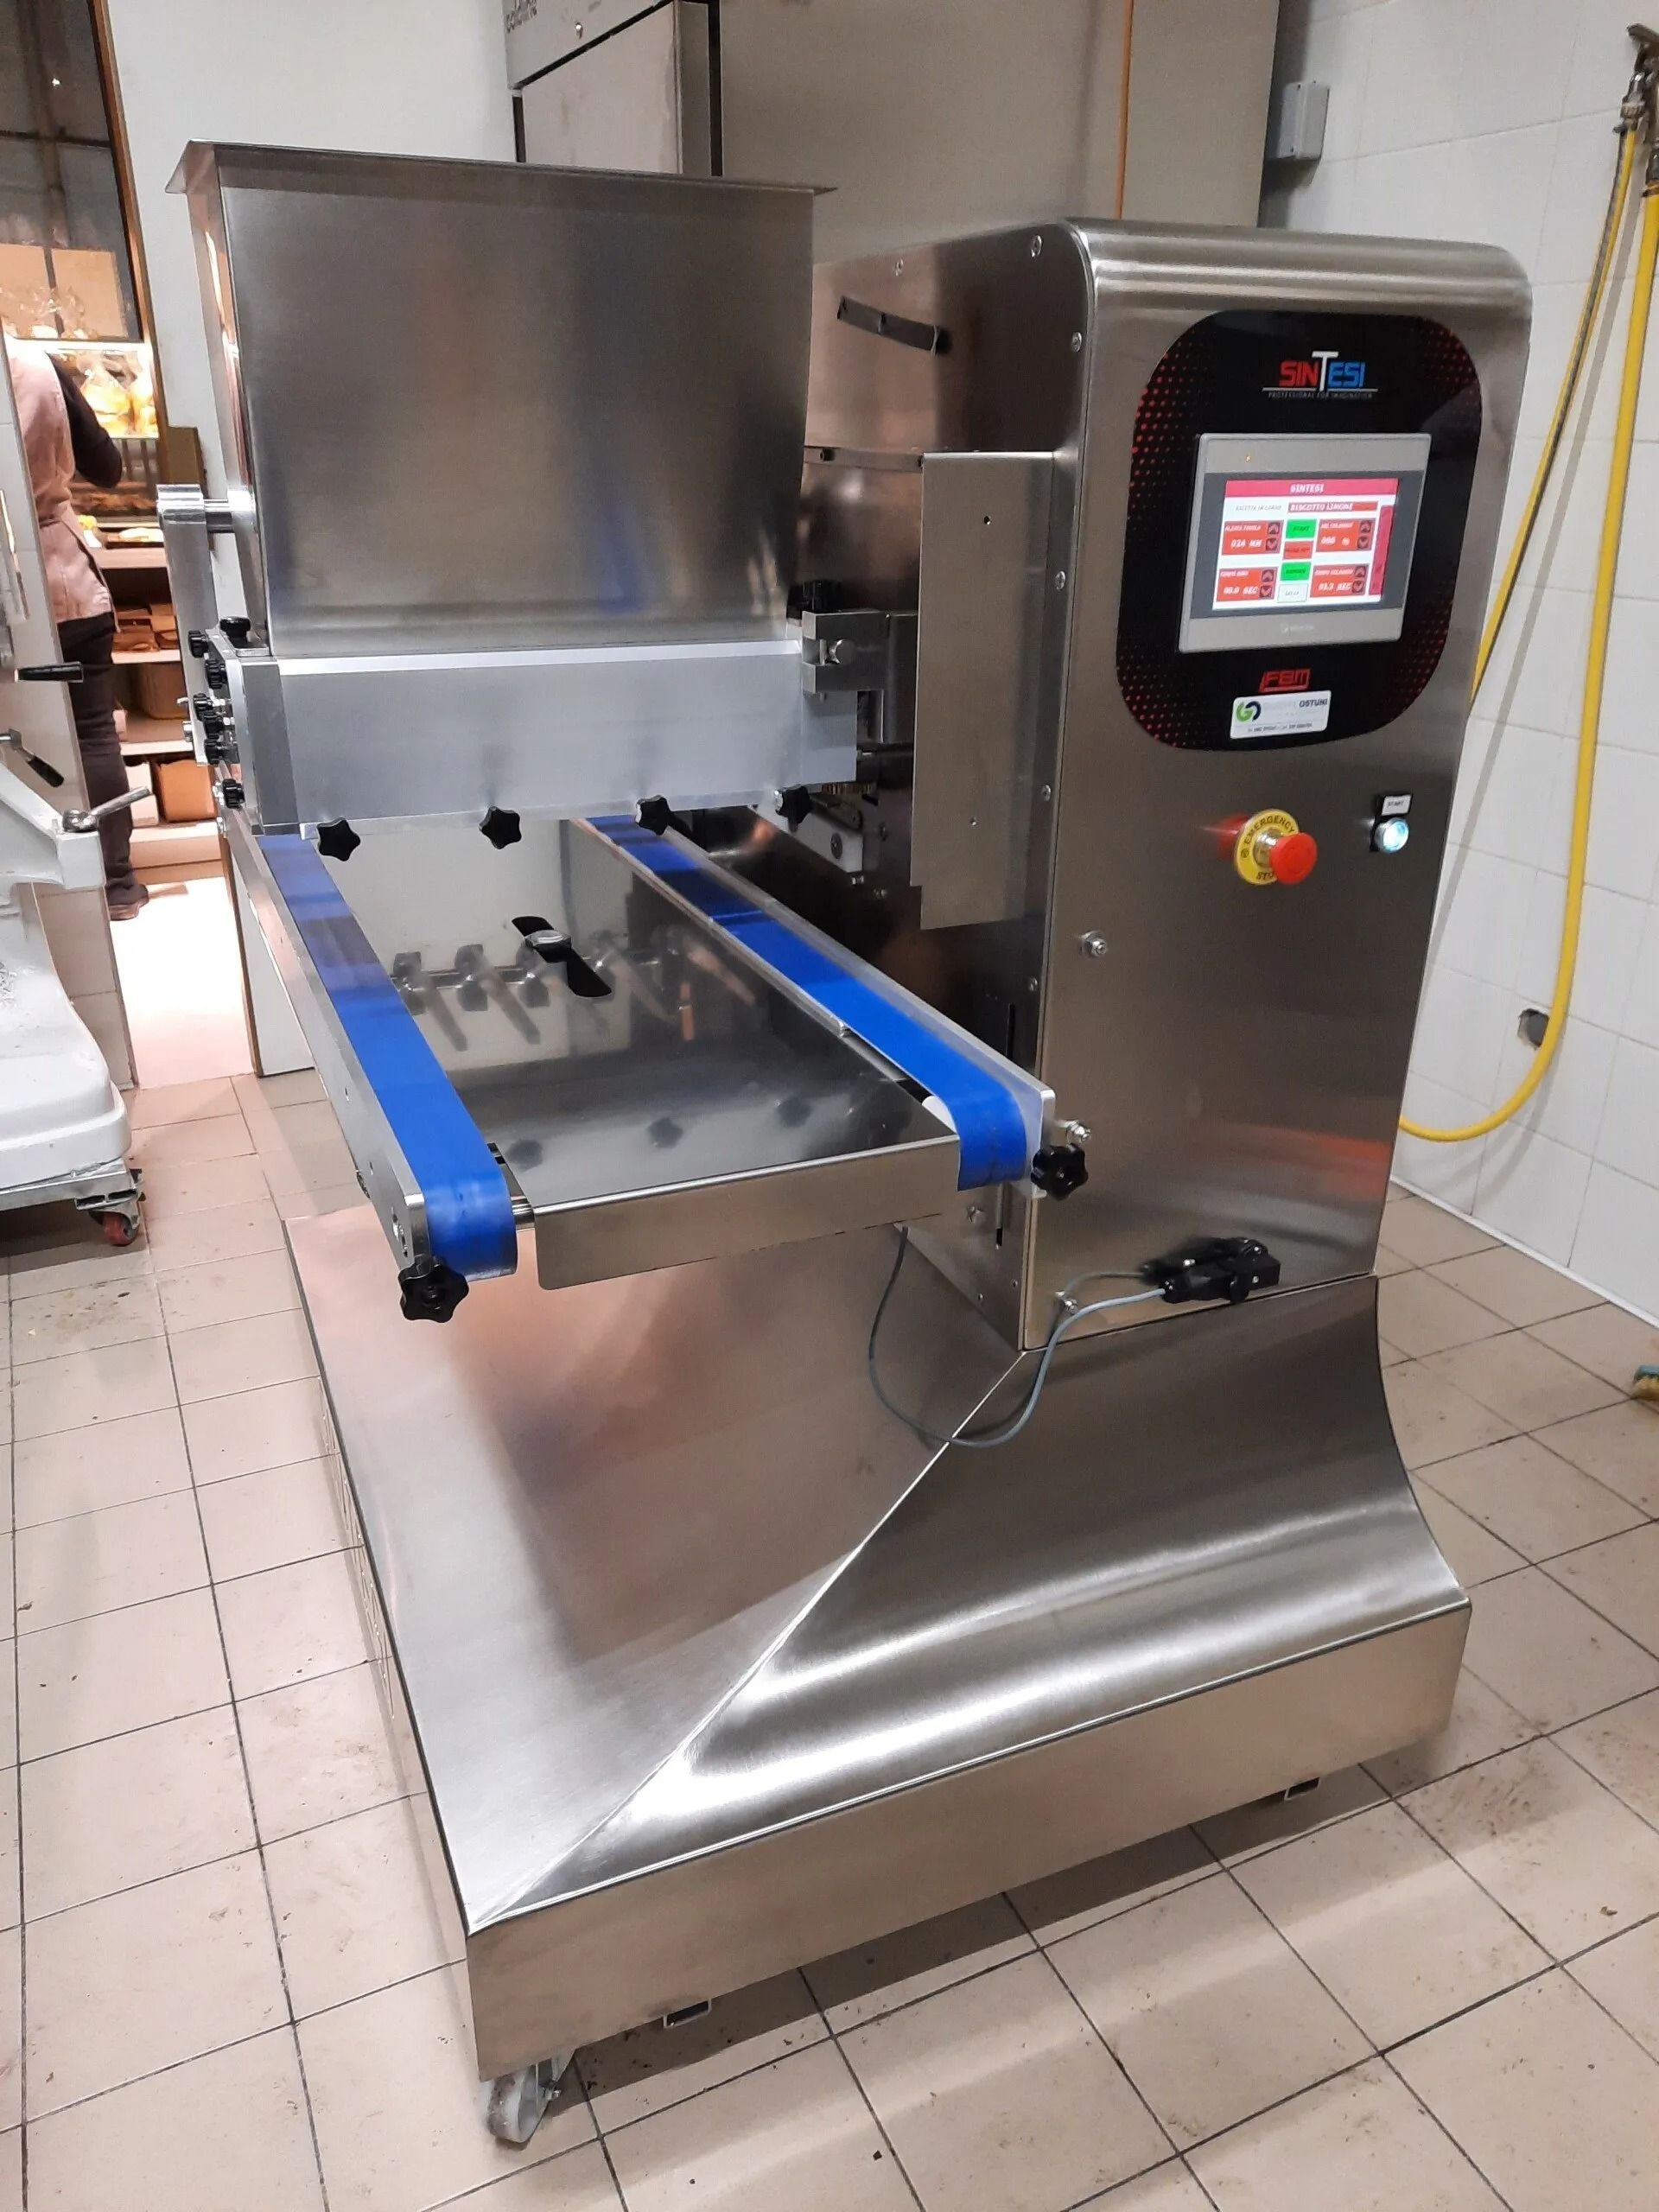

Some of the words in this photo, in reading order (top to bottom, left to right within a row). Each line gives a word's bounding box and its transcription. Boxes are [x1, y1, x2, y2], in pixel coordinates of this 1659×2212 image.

[1279, 351, 1366, 391] SINTESI
[1290, 483, 1325, 493] SINTESI
[1290, 502, 1325, 512] BISCOTTO
[1299, 698, 1328, 709] OSTUNI
[1244, 815, 1295, 844] EMERGENCY
